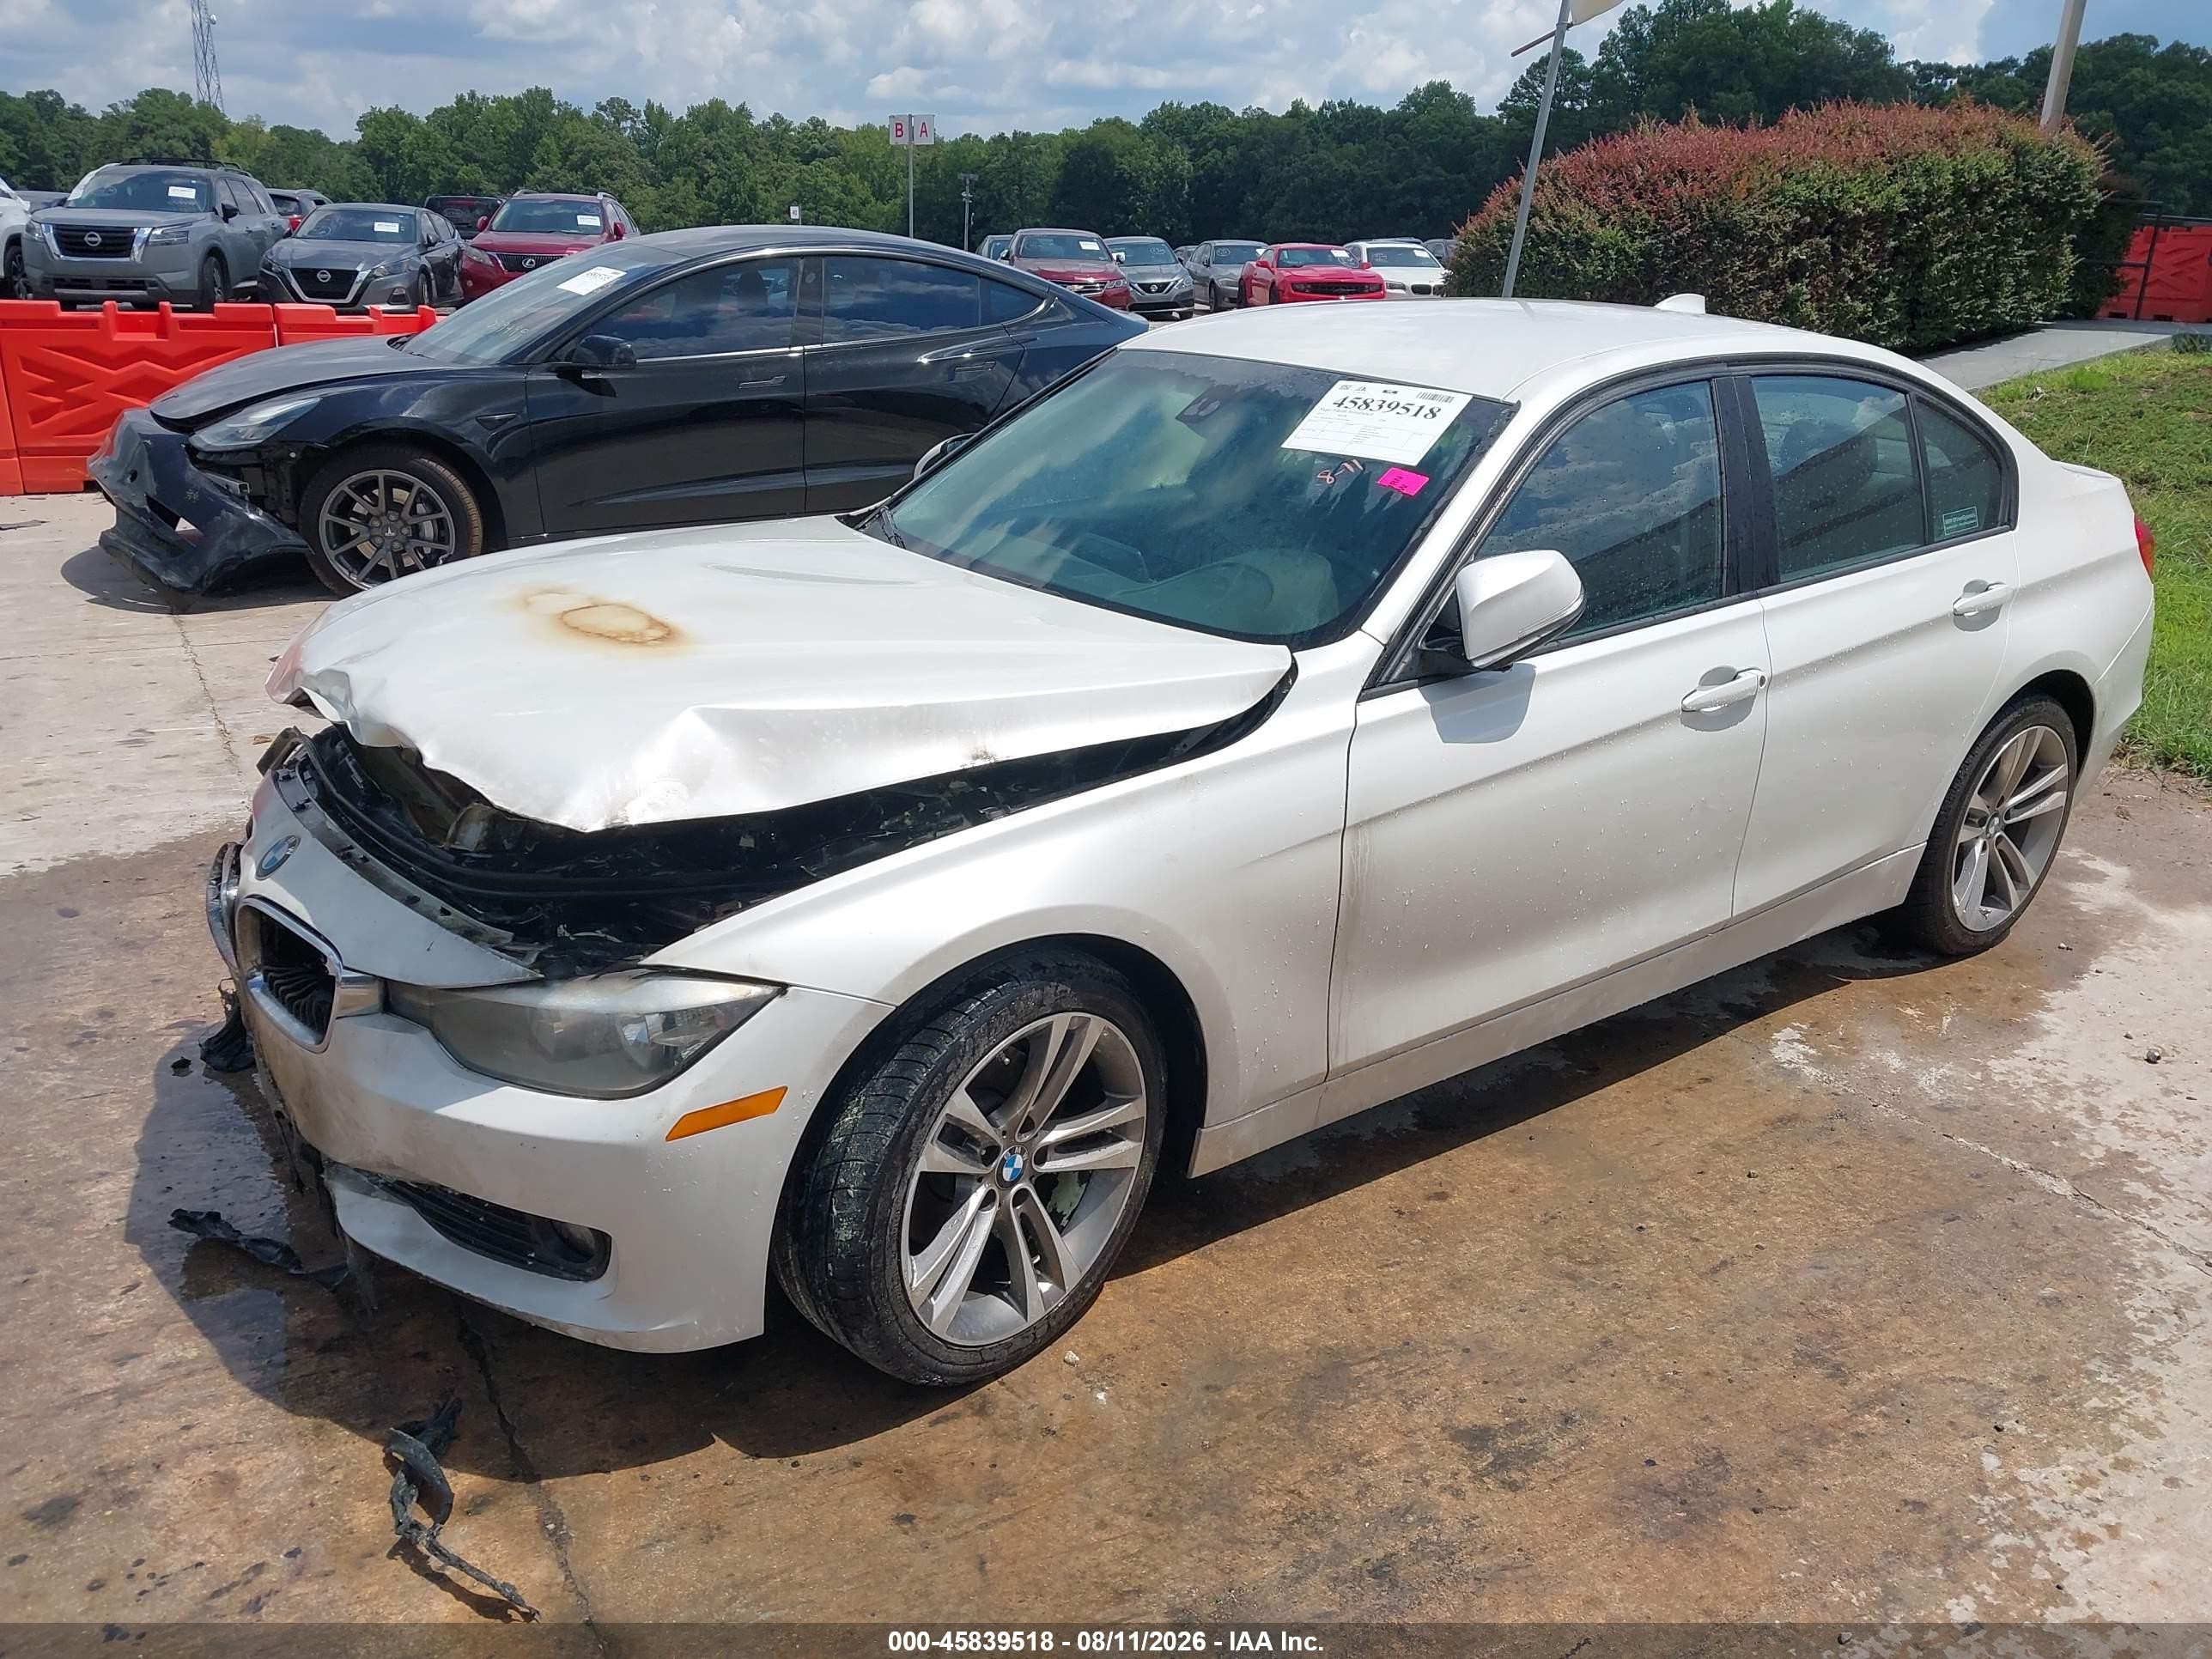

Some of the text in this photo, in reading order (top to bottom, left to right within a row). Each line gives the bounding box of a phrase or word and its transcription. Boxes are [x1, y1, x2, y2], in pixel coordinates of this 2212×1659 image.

[895, 123, 904, 138] B
[920, 122, 928, 138] A
[1332, 396, 1442, 420] 45839518
[1003, 1146, 1029, 1161] BMW
